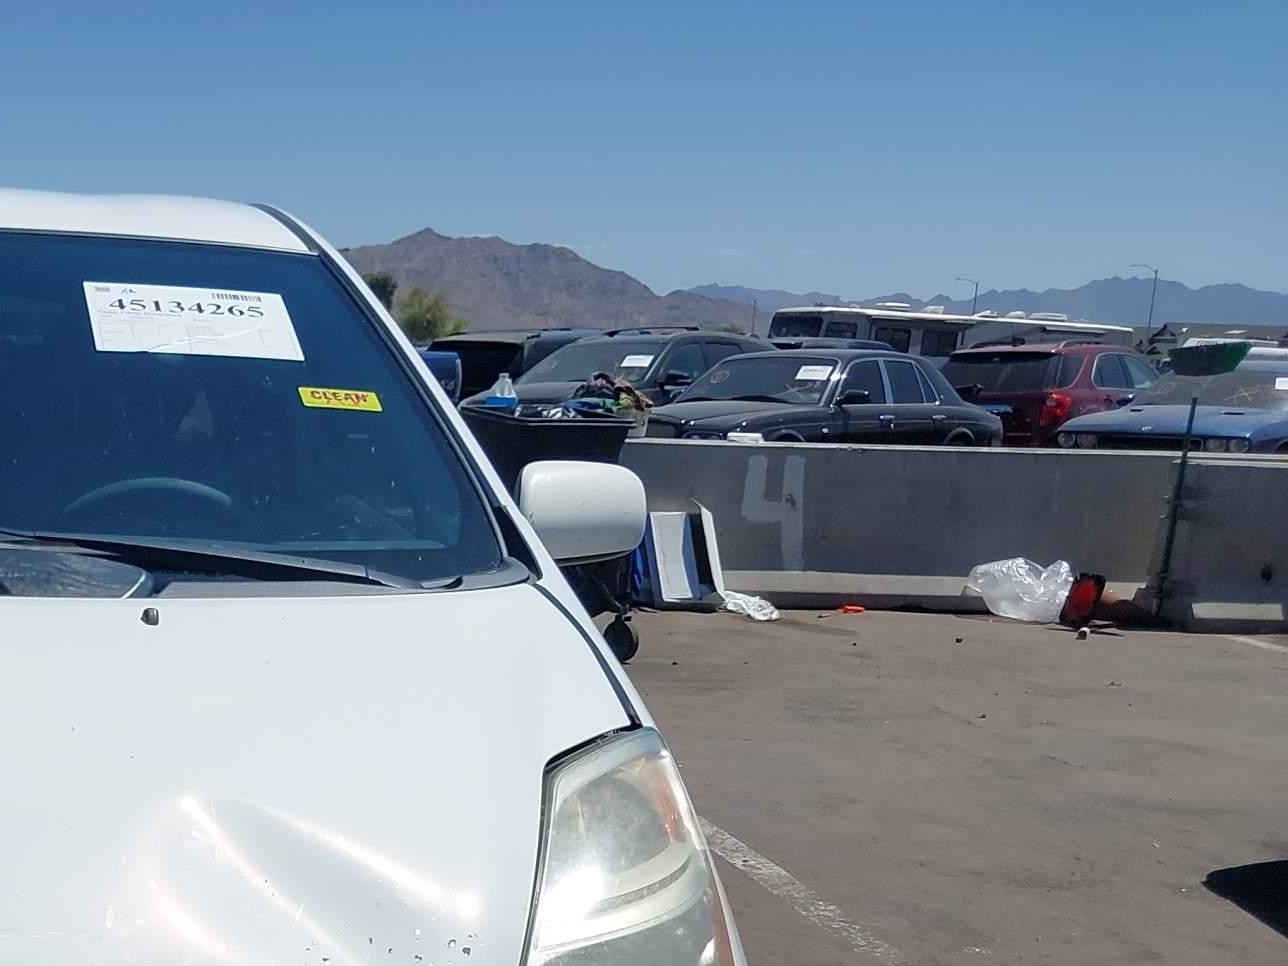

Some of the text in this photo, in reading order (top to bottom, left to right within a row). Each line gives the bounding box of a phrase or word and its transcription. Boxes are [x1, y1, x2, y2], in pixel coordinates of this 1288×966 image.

[109, 298, 264, 318] 45134265
[310, 390, 368, 403] CLEAN
[741, 454, 805, 569] 4
